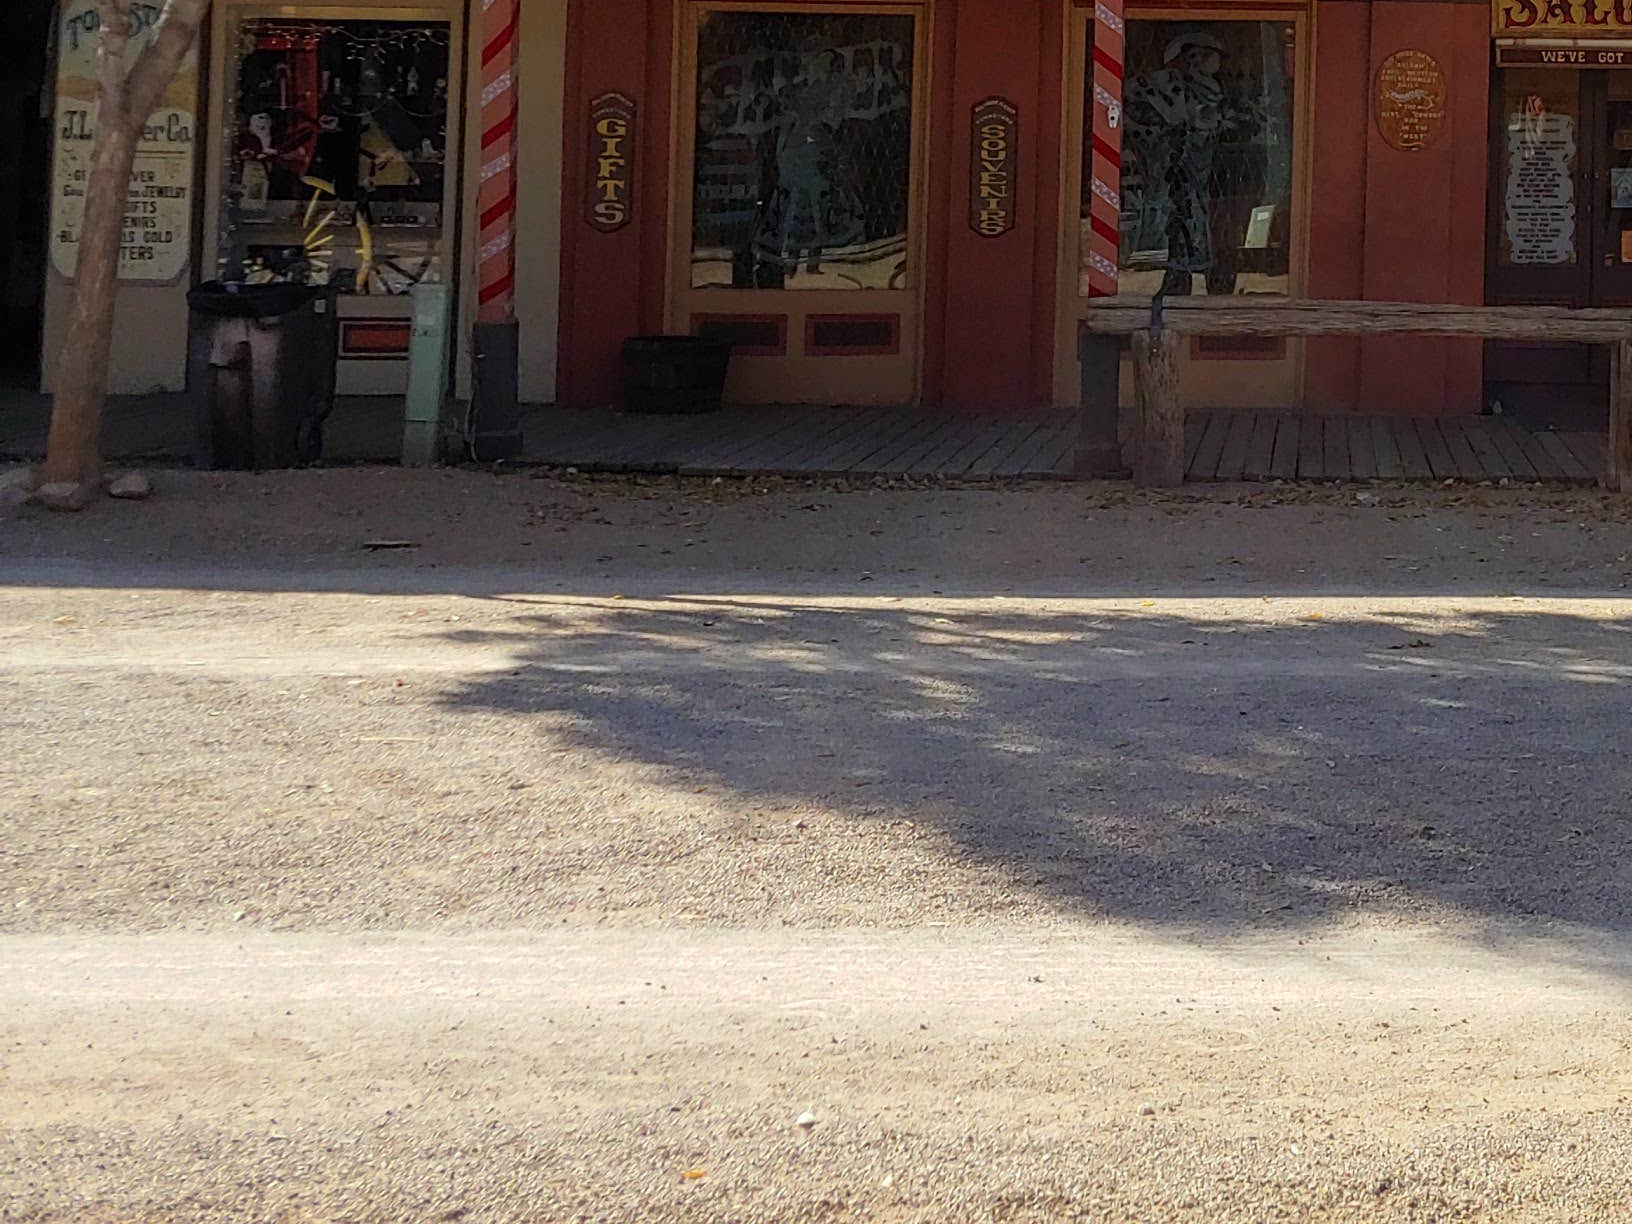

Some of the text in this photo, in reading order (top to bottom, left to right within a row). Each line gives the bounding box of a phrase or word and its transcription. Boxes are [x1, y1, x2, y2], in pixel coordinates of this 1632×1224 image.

[1541, 50, 1587, 63] WE'VE
[1598, 52, 1624, 64] GOT
[594, 118, 627, 224] GIFTS
[979, 124, 1008, 235] SOUVENIRS
